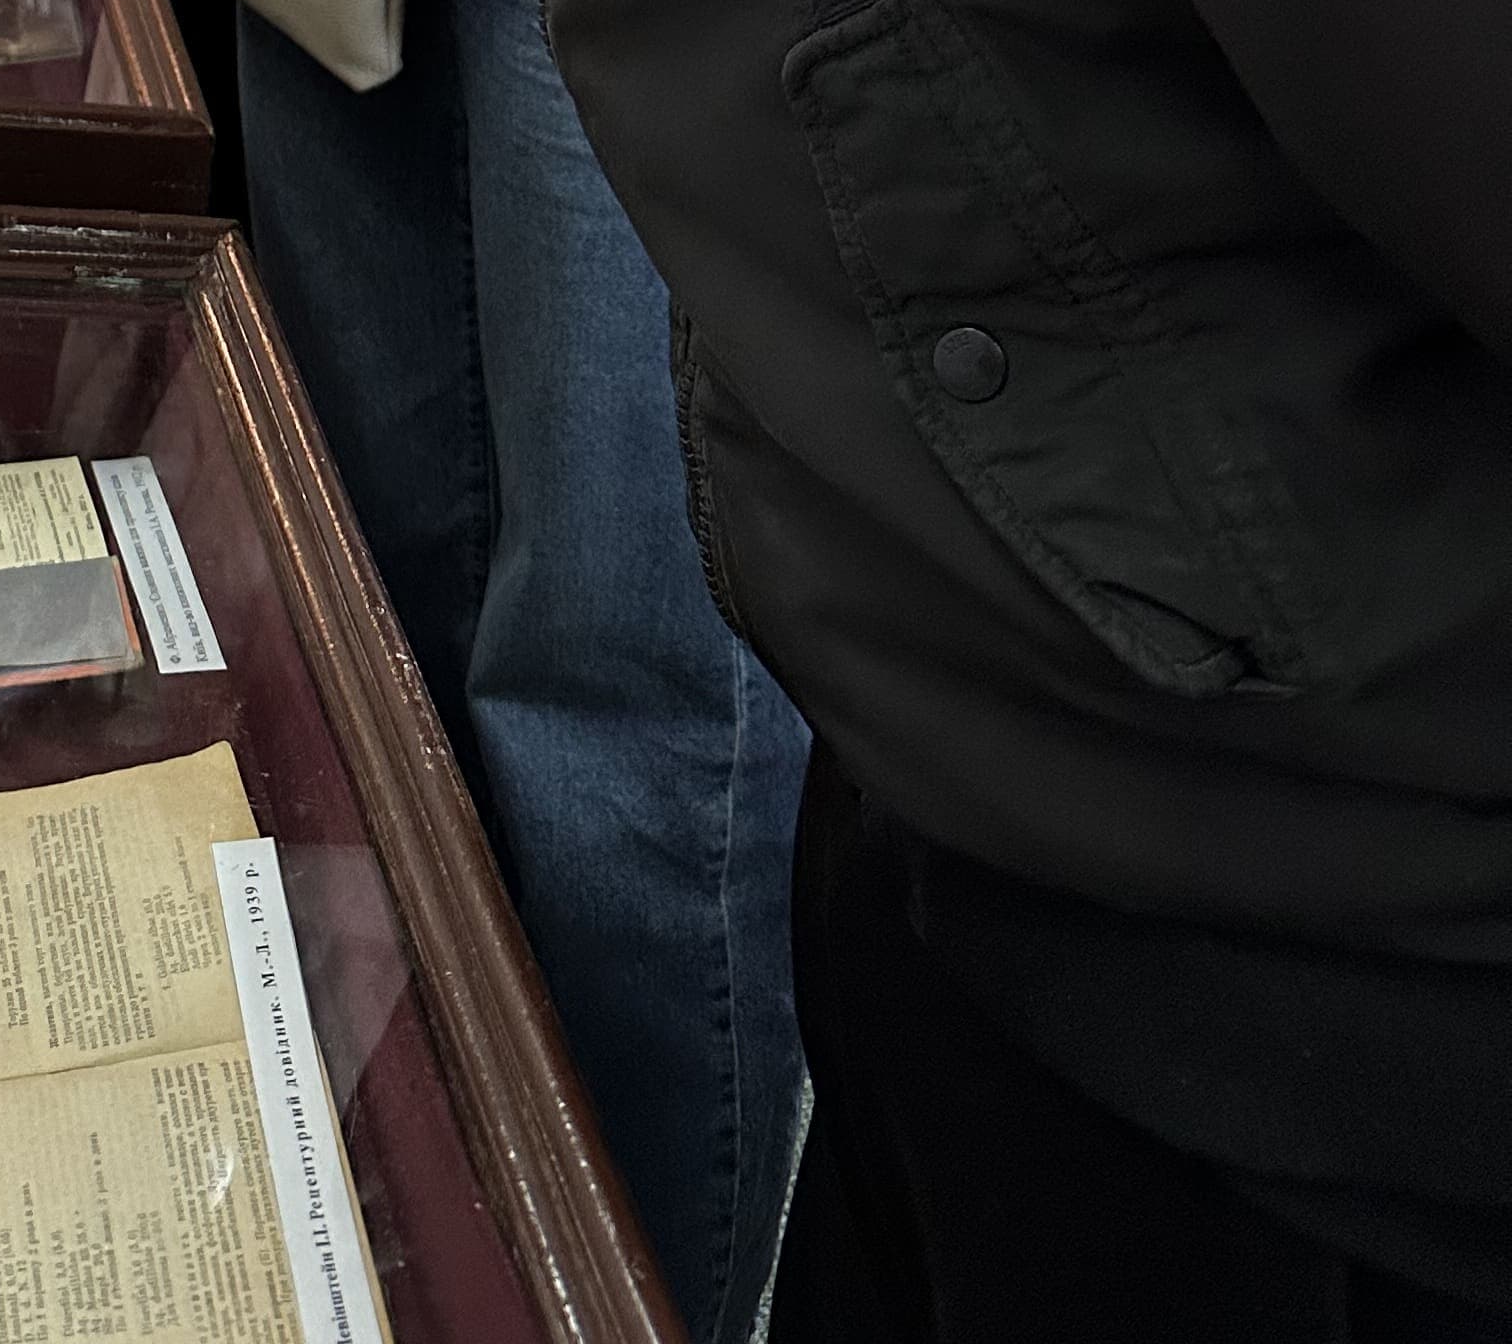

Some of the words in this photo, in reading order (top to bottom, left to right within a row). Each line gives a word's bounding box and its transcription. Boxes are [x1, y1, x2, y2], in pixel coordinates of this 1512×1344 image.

[241, 861, 260, 878] р.
[243, 885, 265, 923] 1939
[264, 995, 299, 1087] довідник.
[284, 1094, 328, 1220] Рецептурний
